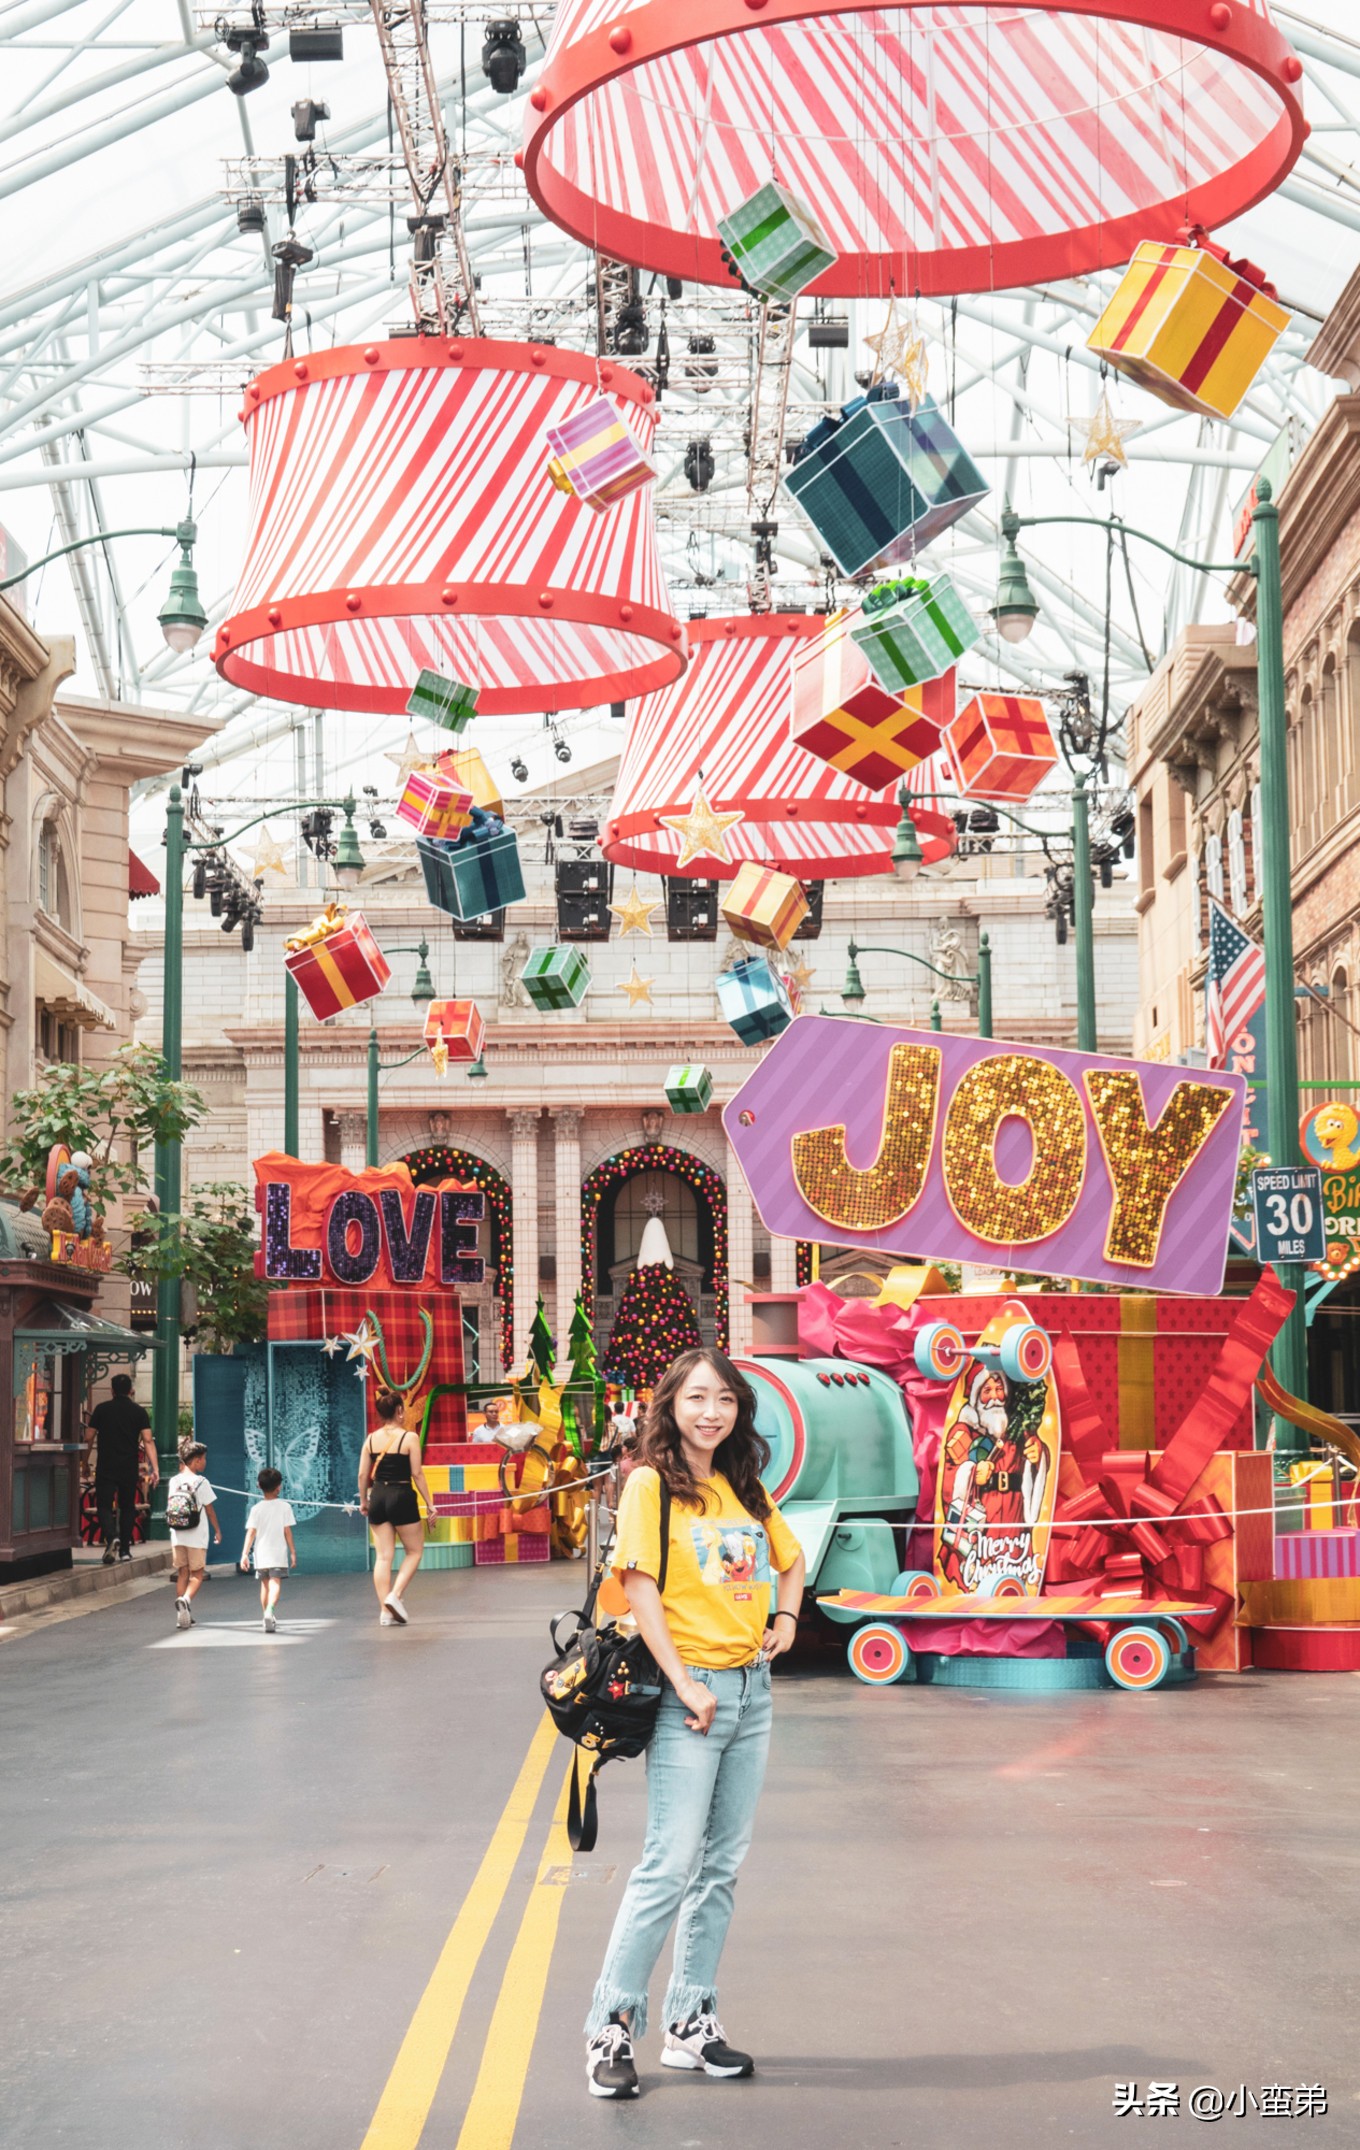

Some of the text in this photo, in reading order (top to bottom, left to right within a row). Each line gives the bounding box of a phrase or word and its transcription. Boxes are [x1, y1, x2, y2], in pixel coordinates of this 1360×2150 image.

[790, 1043, 1235, 1268] JOY
[1257, 1173, 1317, 1191] SPEED LIMIT
[265, 1182, 485, 1284] LOVE
[1265, 1193, 1313, 1236] 30
[1277, 1239, 1305, 1255] MILES
[968, 1530, 1031, 1564] Merry
[963, 1550, 1042, 1587] Christmas
